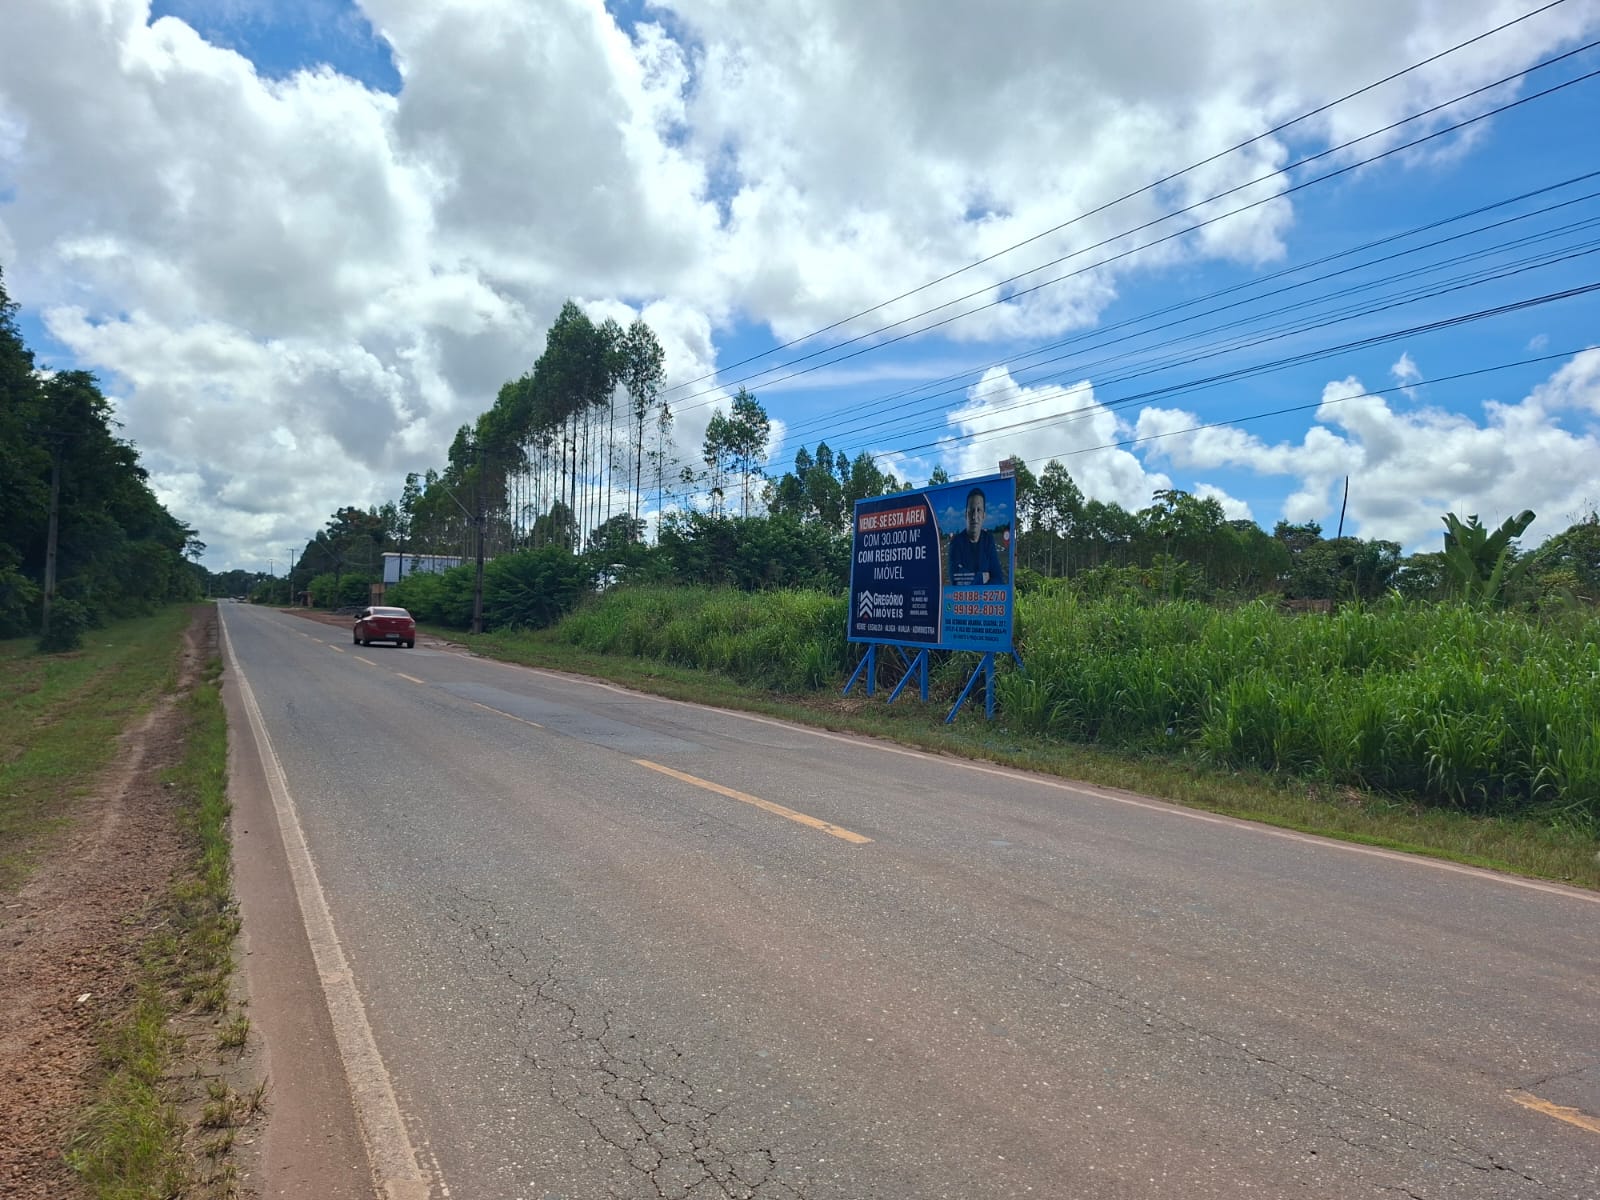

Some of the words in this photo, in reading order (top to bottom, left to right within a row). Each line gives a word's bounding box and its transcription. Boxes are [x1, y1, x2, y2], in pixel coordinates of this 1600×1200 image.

[859, 514, 888, 530] VENDE-SE
[888, 511, 904, 527] ESTA
[905, 507, 925, 524] ÁREA
[863, 533, 880, 548] COM
[881, 530, 907, 546] 30.000
[909, 528, 921, 543] M²
[858, 550, 874, 564] COM
[875, 546, 913, 563] REGISTRO
[915, 545, 927, 560] DE
[873, 563, 905, 580] IMÓVEL
[873, 591, 904, 606] GREGÓRIO
[953, 590, 1007, 602] 98188-5270
[873, 605, 904, 619] IMÓVEIS
[953, 604, 1006, 616] 99192-8013
